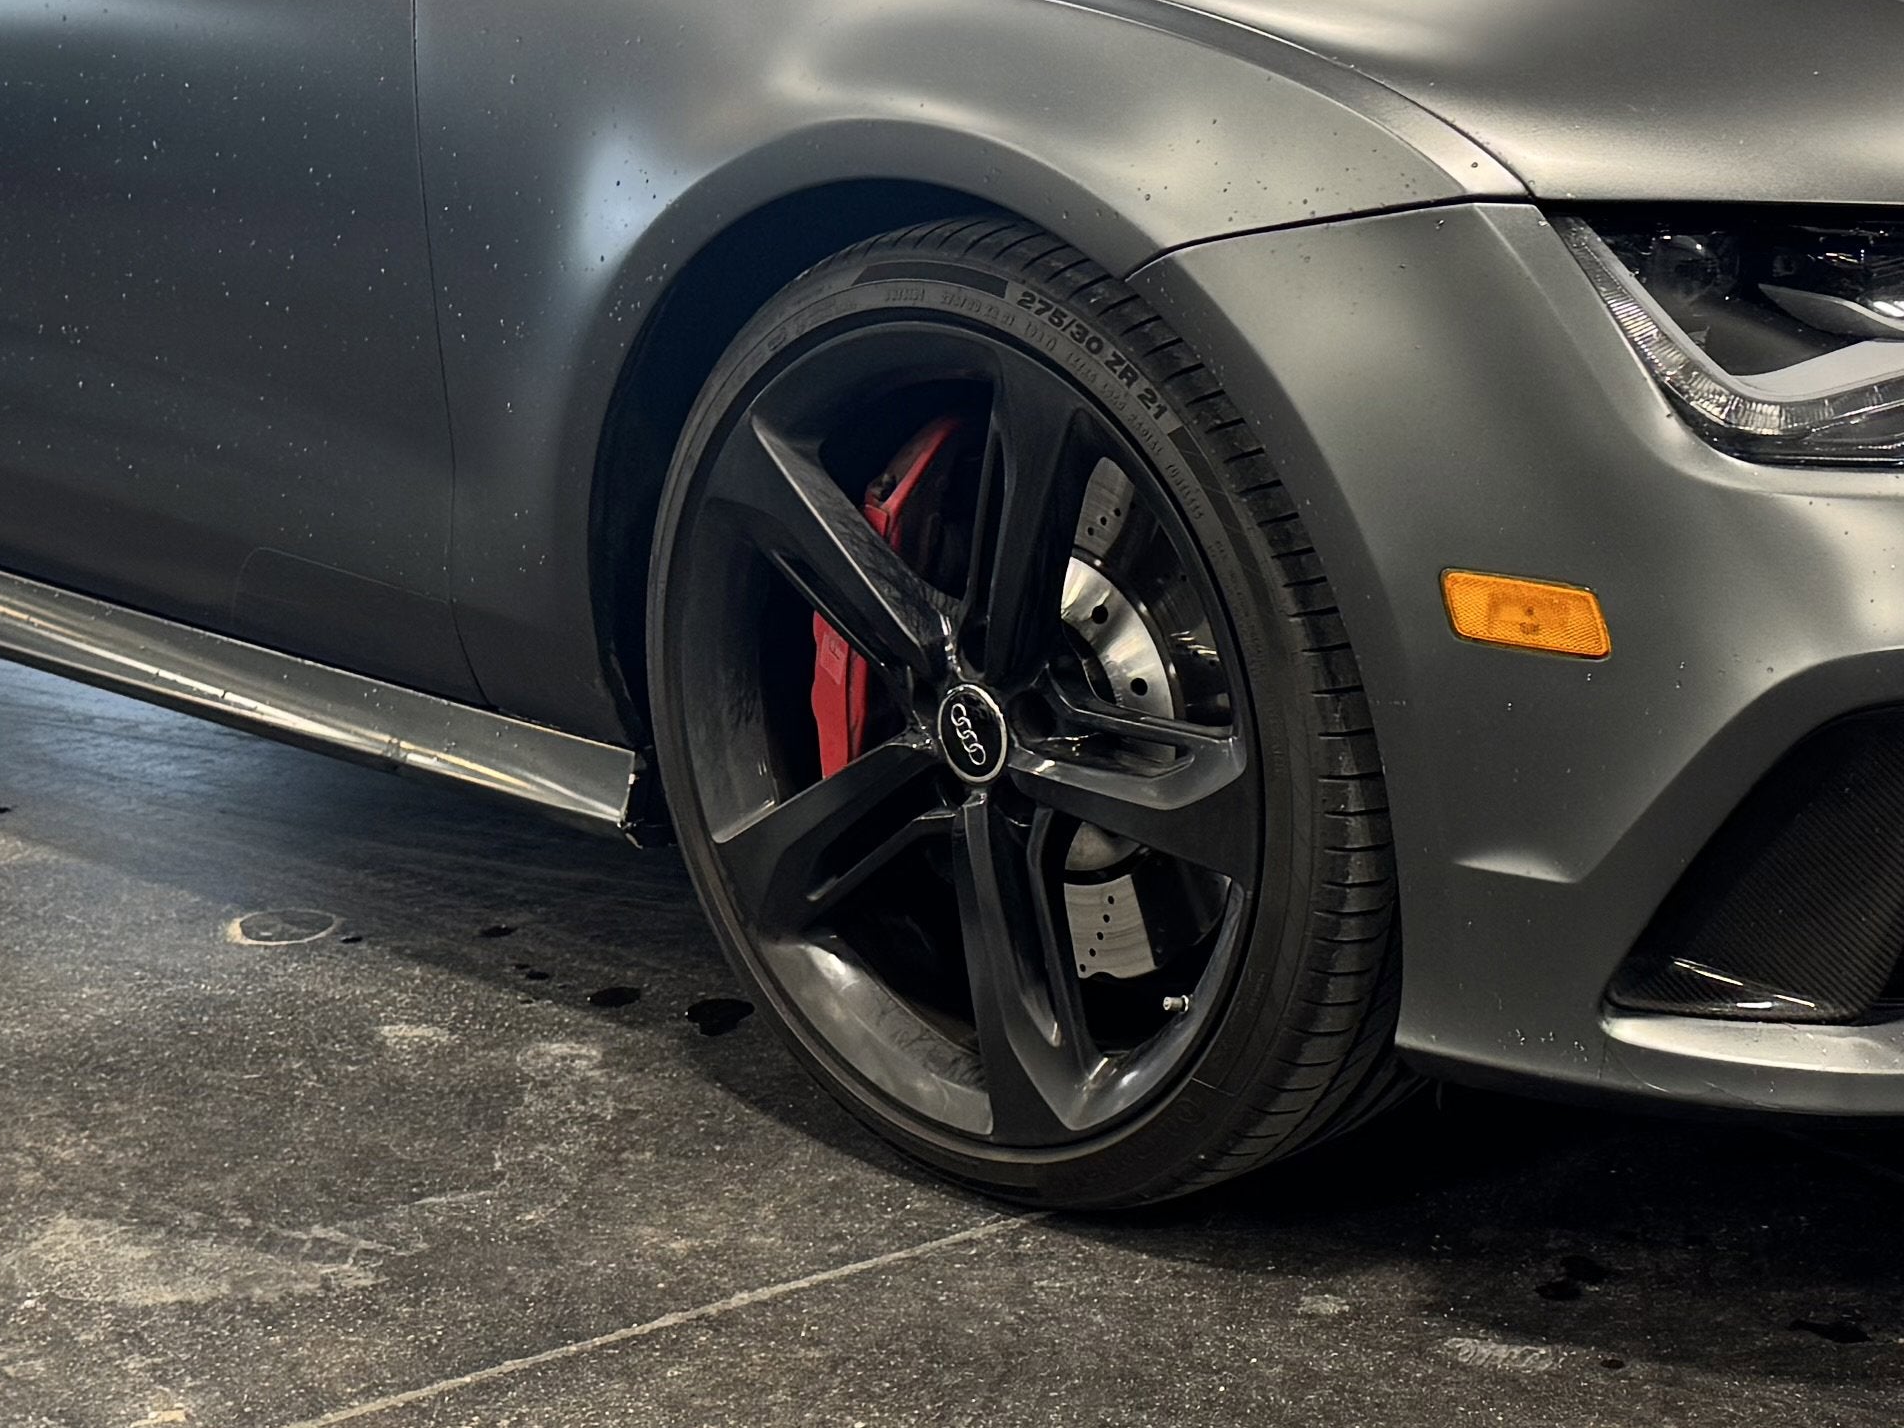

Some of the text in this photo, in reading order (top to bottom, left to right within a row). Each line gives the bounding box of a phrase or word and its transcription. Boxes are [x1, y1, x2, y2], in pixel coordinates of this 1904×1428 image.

[1016, 290, 1104, 355] 275/30
[1104, 350, 1140, 389] ZR
[1136, 387, 1169, 420] 21
